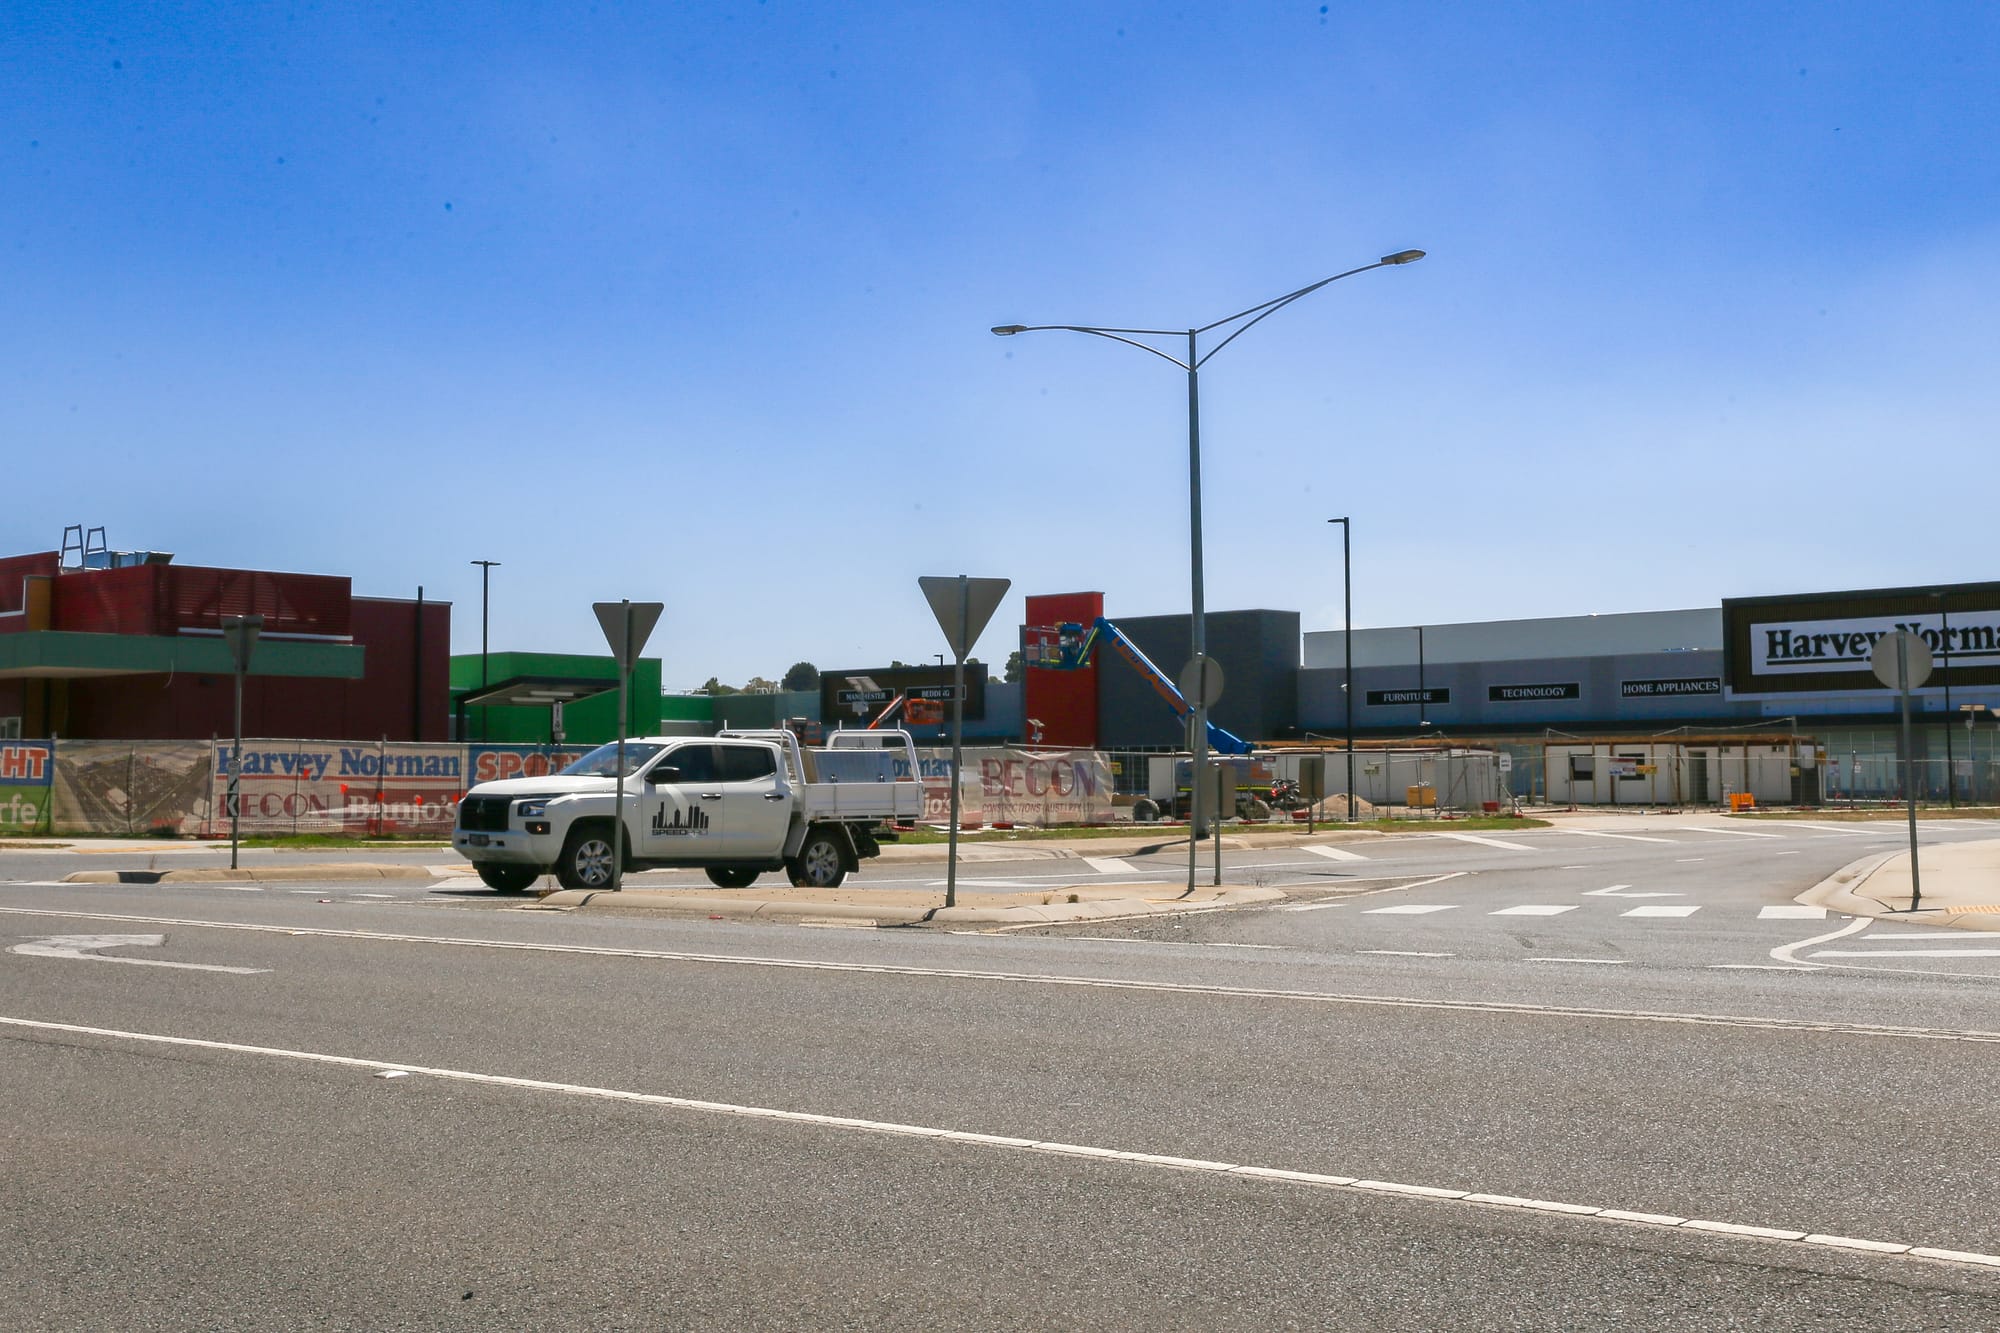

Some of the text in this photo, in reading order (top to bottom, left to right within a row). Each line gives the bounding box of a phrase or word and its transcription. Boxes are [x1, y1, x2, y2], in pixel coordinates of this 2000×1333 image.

[1765, 622, 2000, 662] Harvey orm
[846, 691, 886, 700] MANHESTER
[1502, 687, 1566, 698] TECHNOLOGY
[1623, 681, 1719, 694] HOME APPLIANCES
[217, 746, 459, 781] Harvey Norman
[981, 758, 1096, 797] BECON
